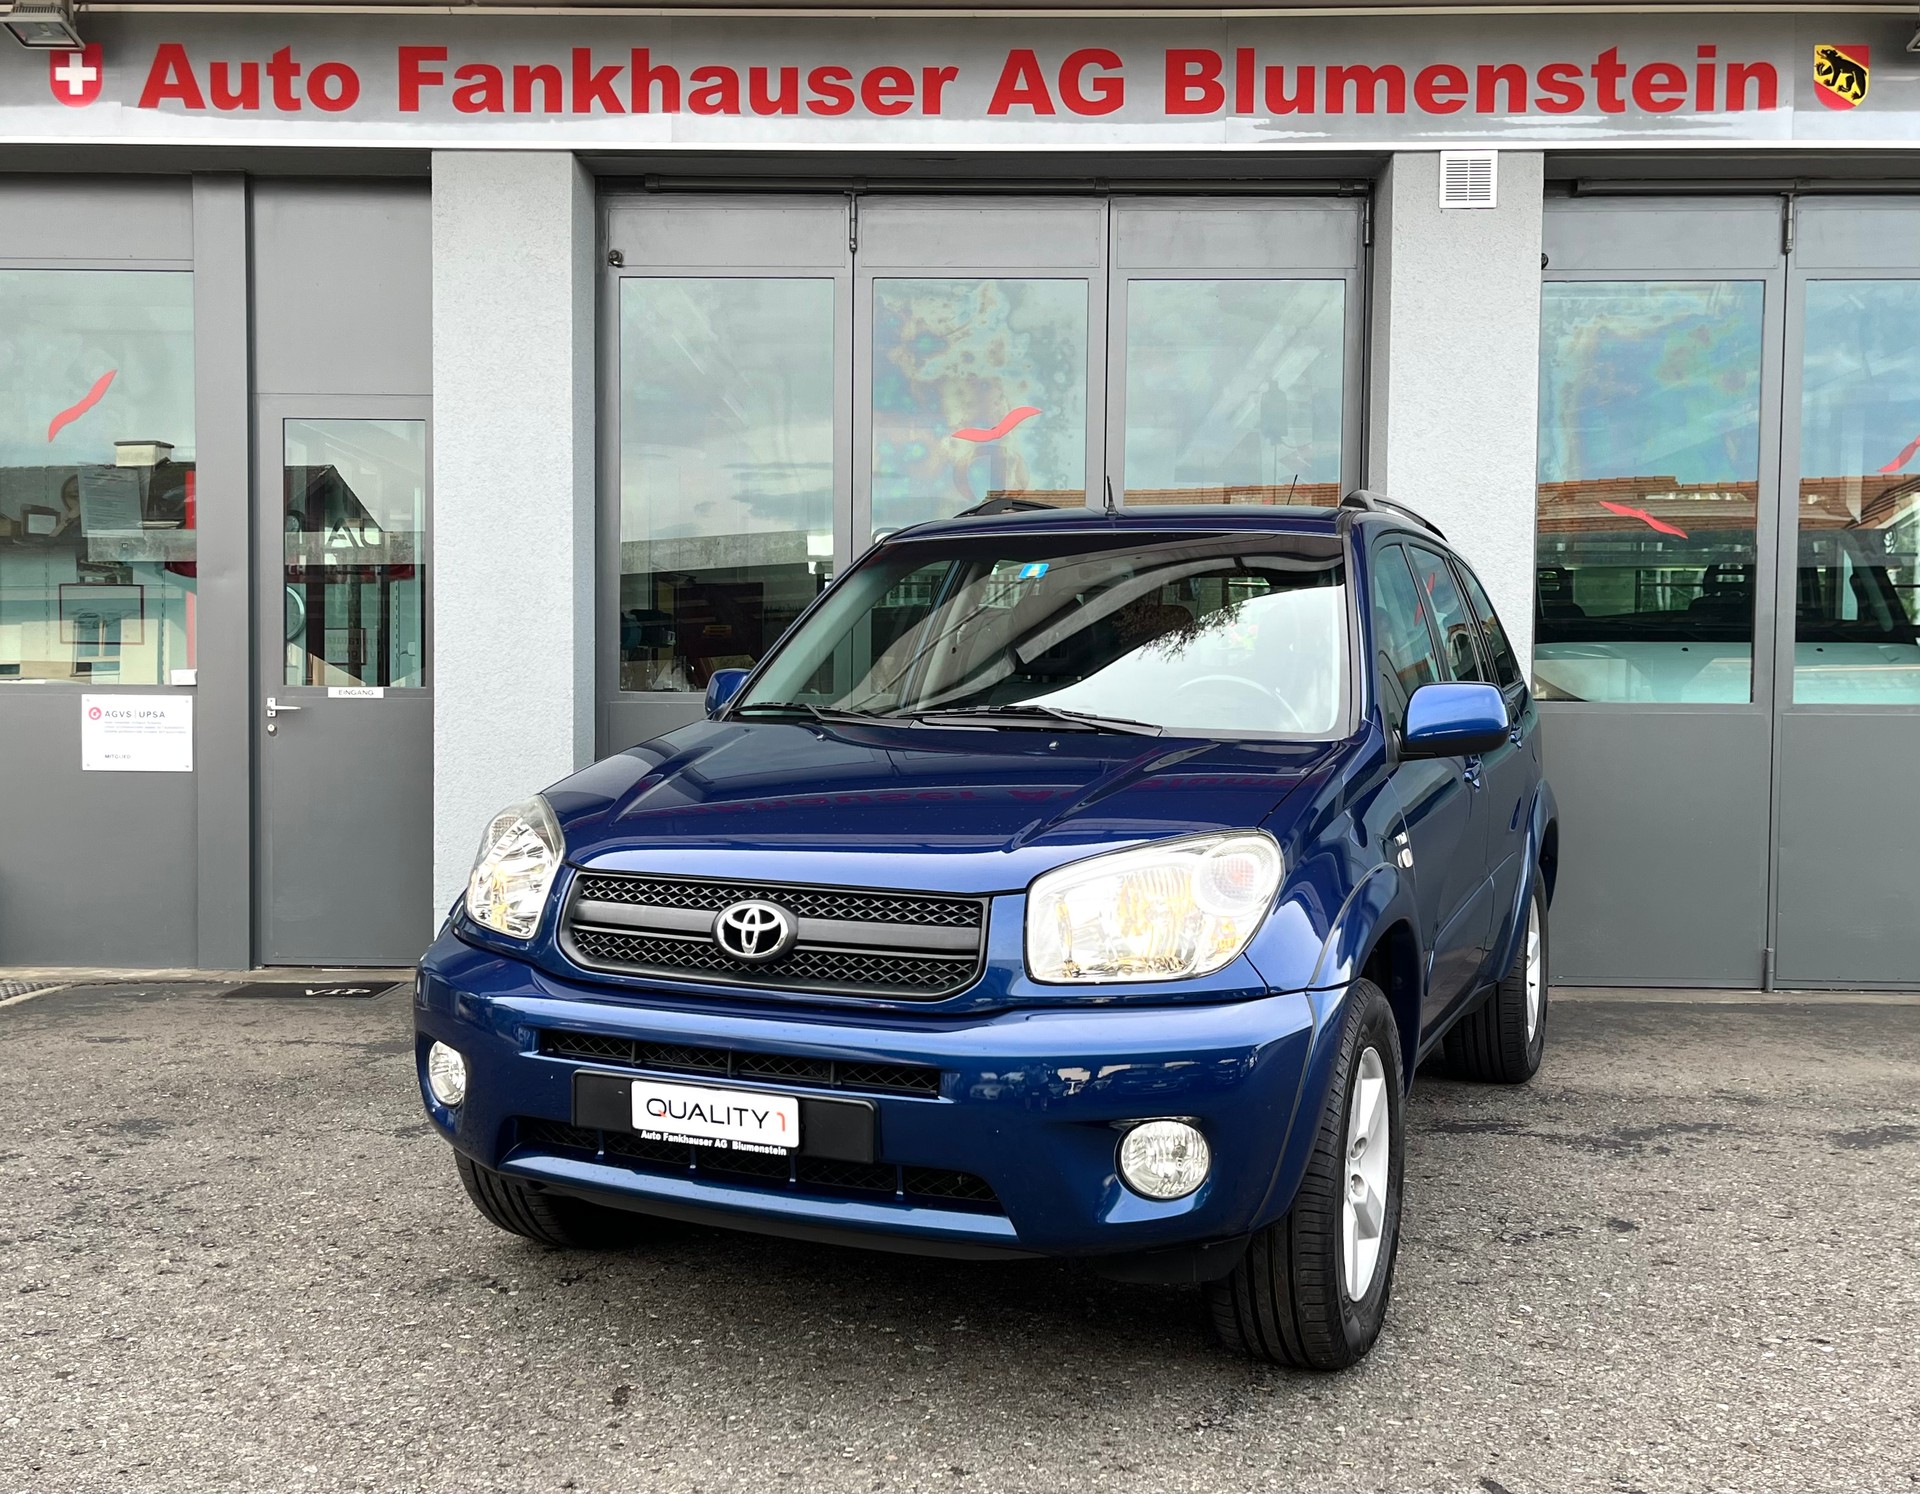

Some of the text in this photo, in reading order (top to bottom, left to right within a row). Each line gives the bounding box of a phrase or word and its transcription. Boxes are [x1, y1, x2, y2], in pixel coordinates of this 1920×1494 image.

[139, 44, 1778, 116] Auto Fankhauser AG Blumenstein
[338, 689, 375, 697] EINGANG
[104, 710, 132, 718] AGVS
[305, 988, 371, 996] VIP
[646, 1097, 770, 1130] QUALITY
[640, 1130, 787, 1156] Auto Fankhauser AG Blumenstein
